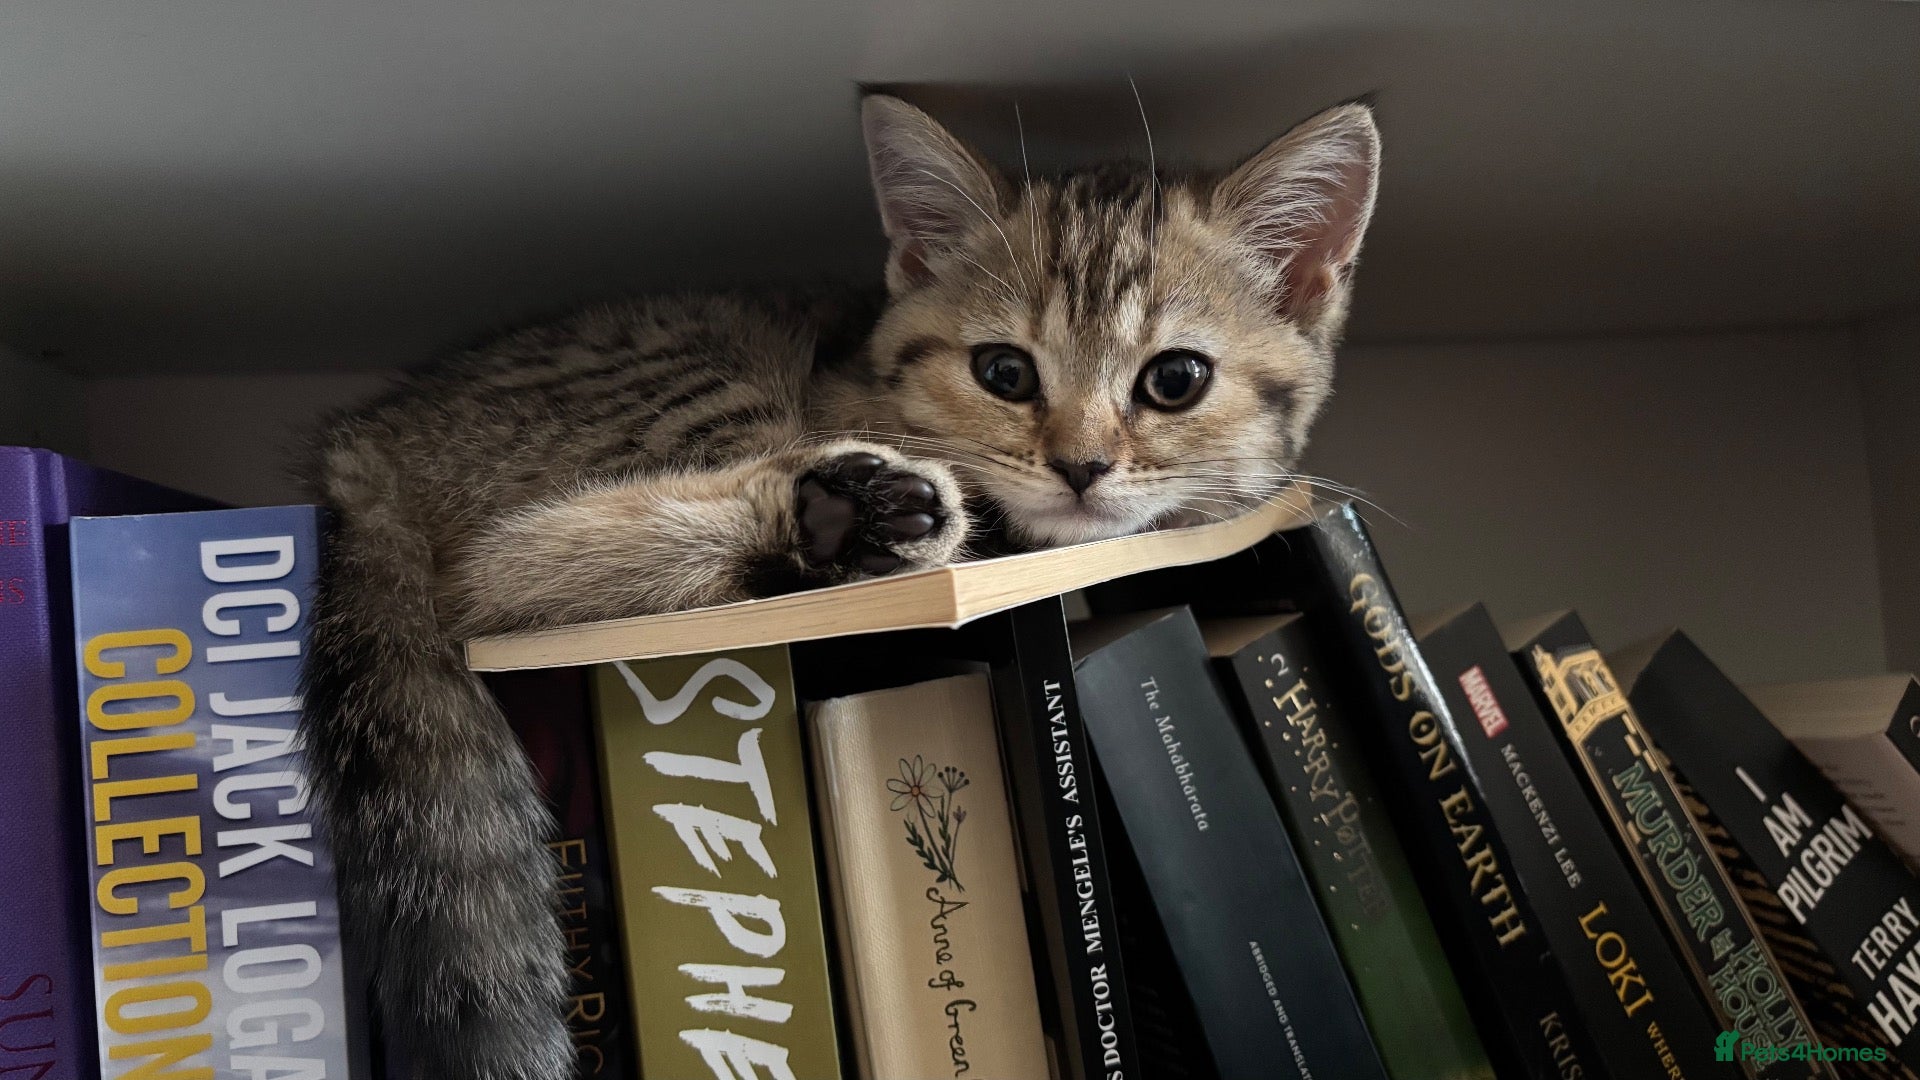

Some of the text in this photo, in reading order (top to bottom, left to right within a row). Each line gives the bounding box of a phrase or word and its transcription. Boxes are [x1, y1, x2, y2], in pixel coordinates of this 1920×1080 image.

[1140, 675, 1160, 711] The
[1270, 653, 1290, 677] 2
[1460, 666, 1508, 737] MARVEL
[1043, 679, 1081, 804] ASSISTANT
[1272, 677, 1340, 802] HARRY
[1349, 573, 1528, 951] GODS ON EARTH
[1735, 765, 1768, 803] I
[84, 627, 215, 1080] COLLECTION
[200, 535, 327, 1080] DCI JACK LOGA
[613, 657, 798, 1080] STEPHE
[1501, 743, 1582, 889] MACKENZI LEE
[1612, 760, 1736, 962] MURDER AT
[1762, 791, 1814, 859] AM
[1776, 803, 1874, 926] PILGRIM
[1065, 814, 1104, 956] MENGELE'S
[1850, 896, 1920, 982] TERRY
[926, 887, 977, 1078] Anne of Green
[1090, 962, 1122, 1068] DOCTOR
[1249, 941, 1279, 998] ABRIDGED
[1272, 999, 1289, 1025] AND
[1578, 901, 1655, 1019] LOKI
[1730, 938, 1811, 1049] HOLLY
